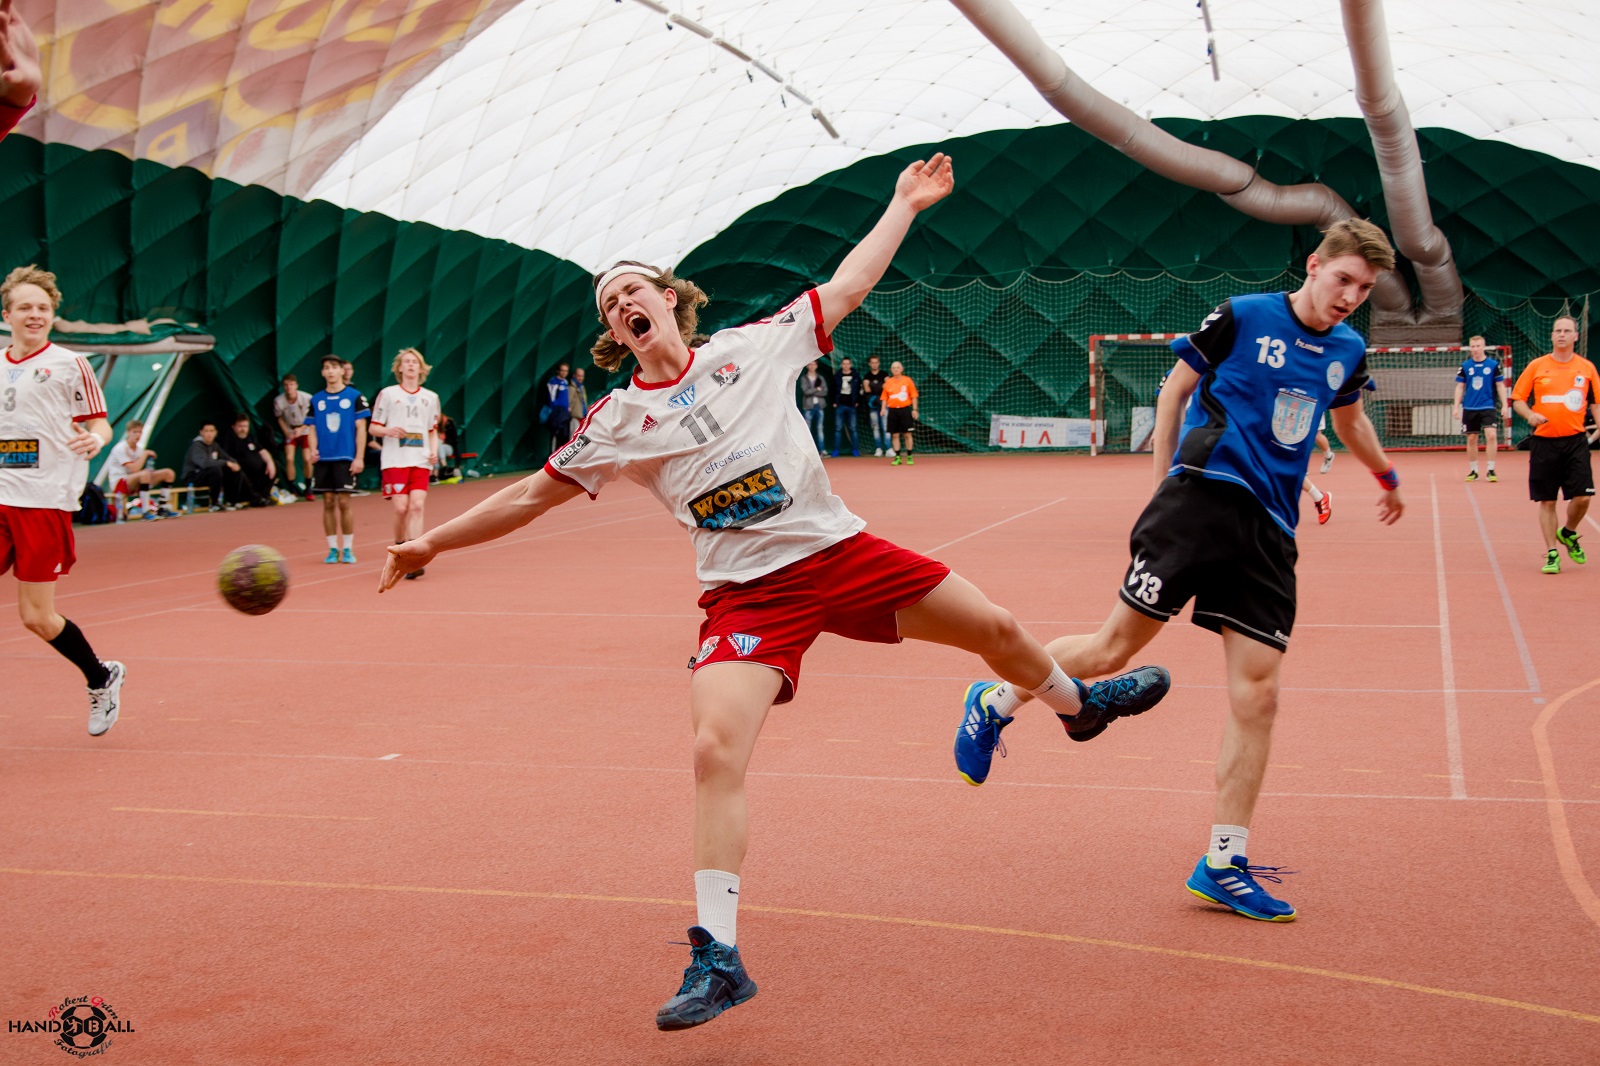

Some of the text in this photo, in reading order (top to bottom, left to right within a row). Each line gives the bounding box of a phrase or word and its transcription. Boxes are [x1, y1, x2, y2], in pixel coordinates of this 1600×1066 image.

[1256, 336, 1287, 368] 13
[4, 387, 17, 412] 3
[318, 400, 326, 411] 6
[671, 384, 696, 408] TIK
[405, 405, 419, 418] 14
[680, 405, 724, 445] 11
[0, 440, 37, 453] ORKS
[704, 441, 766, 475] efterslægten
[693, 468, 777, 518] WORKS
[701, 485, 789, 531] ONLINE
[1135, 572, 1163, 605] 13
[734, 634, 759, 655] TIK
